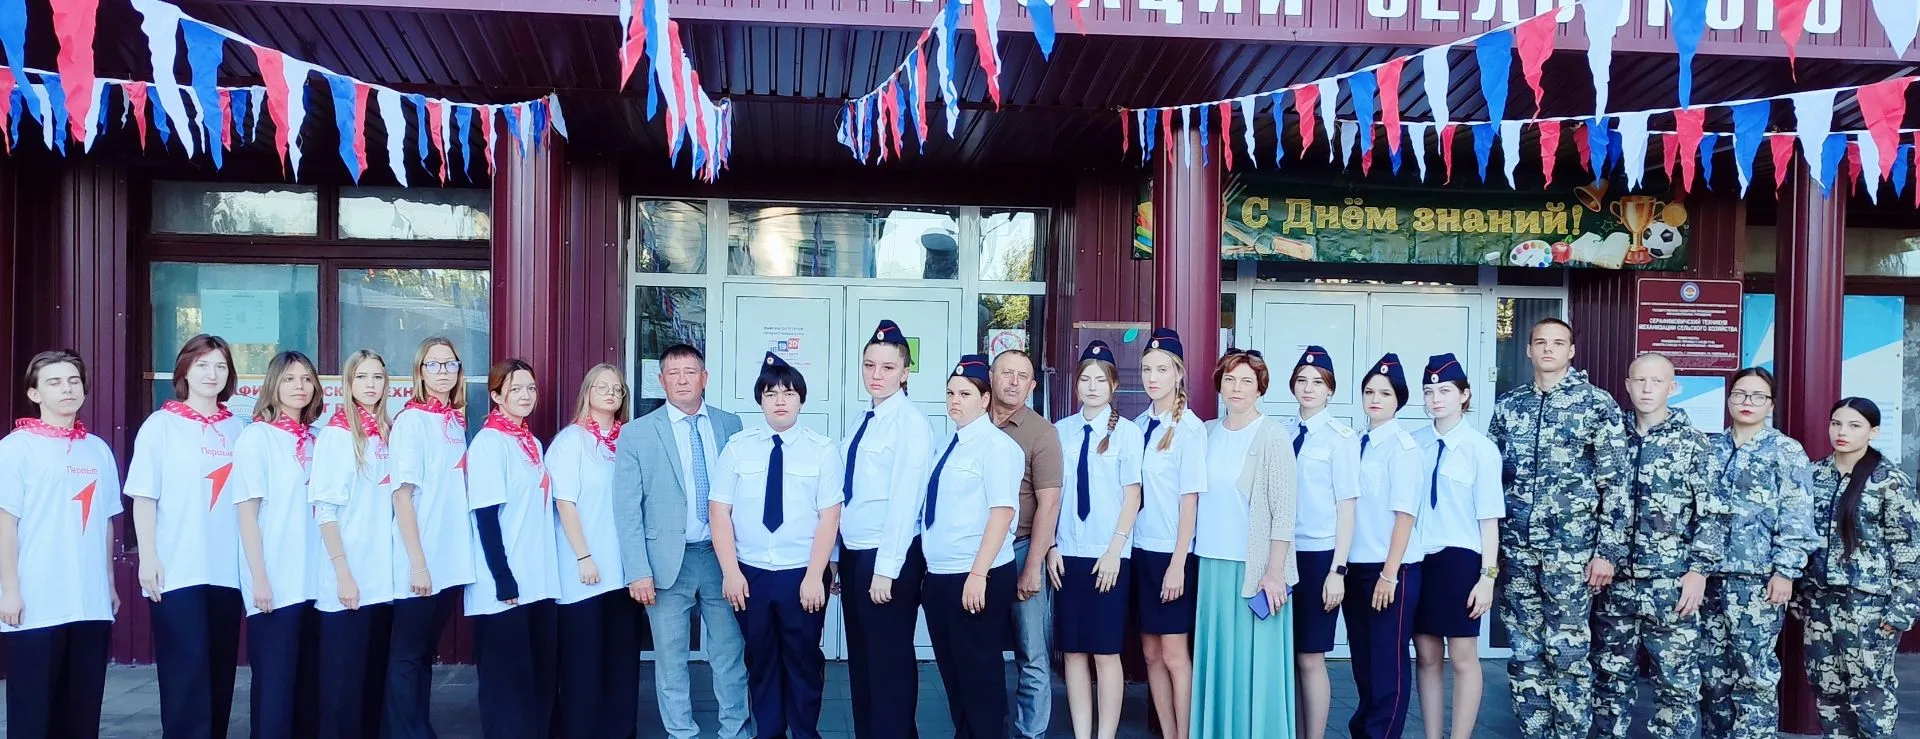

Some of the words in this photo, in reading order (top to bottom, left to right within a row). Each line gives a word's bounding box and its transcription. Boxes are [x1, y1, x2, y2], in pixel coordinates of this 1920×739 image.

[1241, 197, 1269, 229] С
[1283, 197, 1399, 235] Днём
[1412, 202, 1583, 235] знаний!
[778, 342, 787, 351] 19
[200, 446, 233, 457] Первые
[66, 465, 98, 477] Первые
